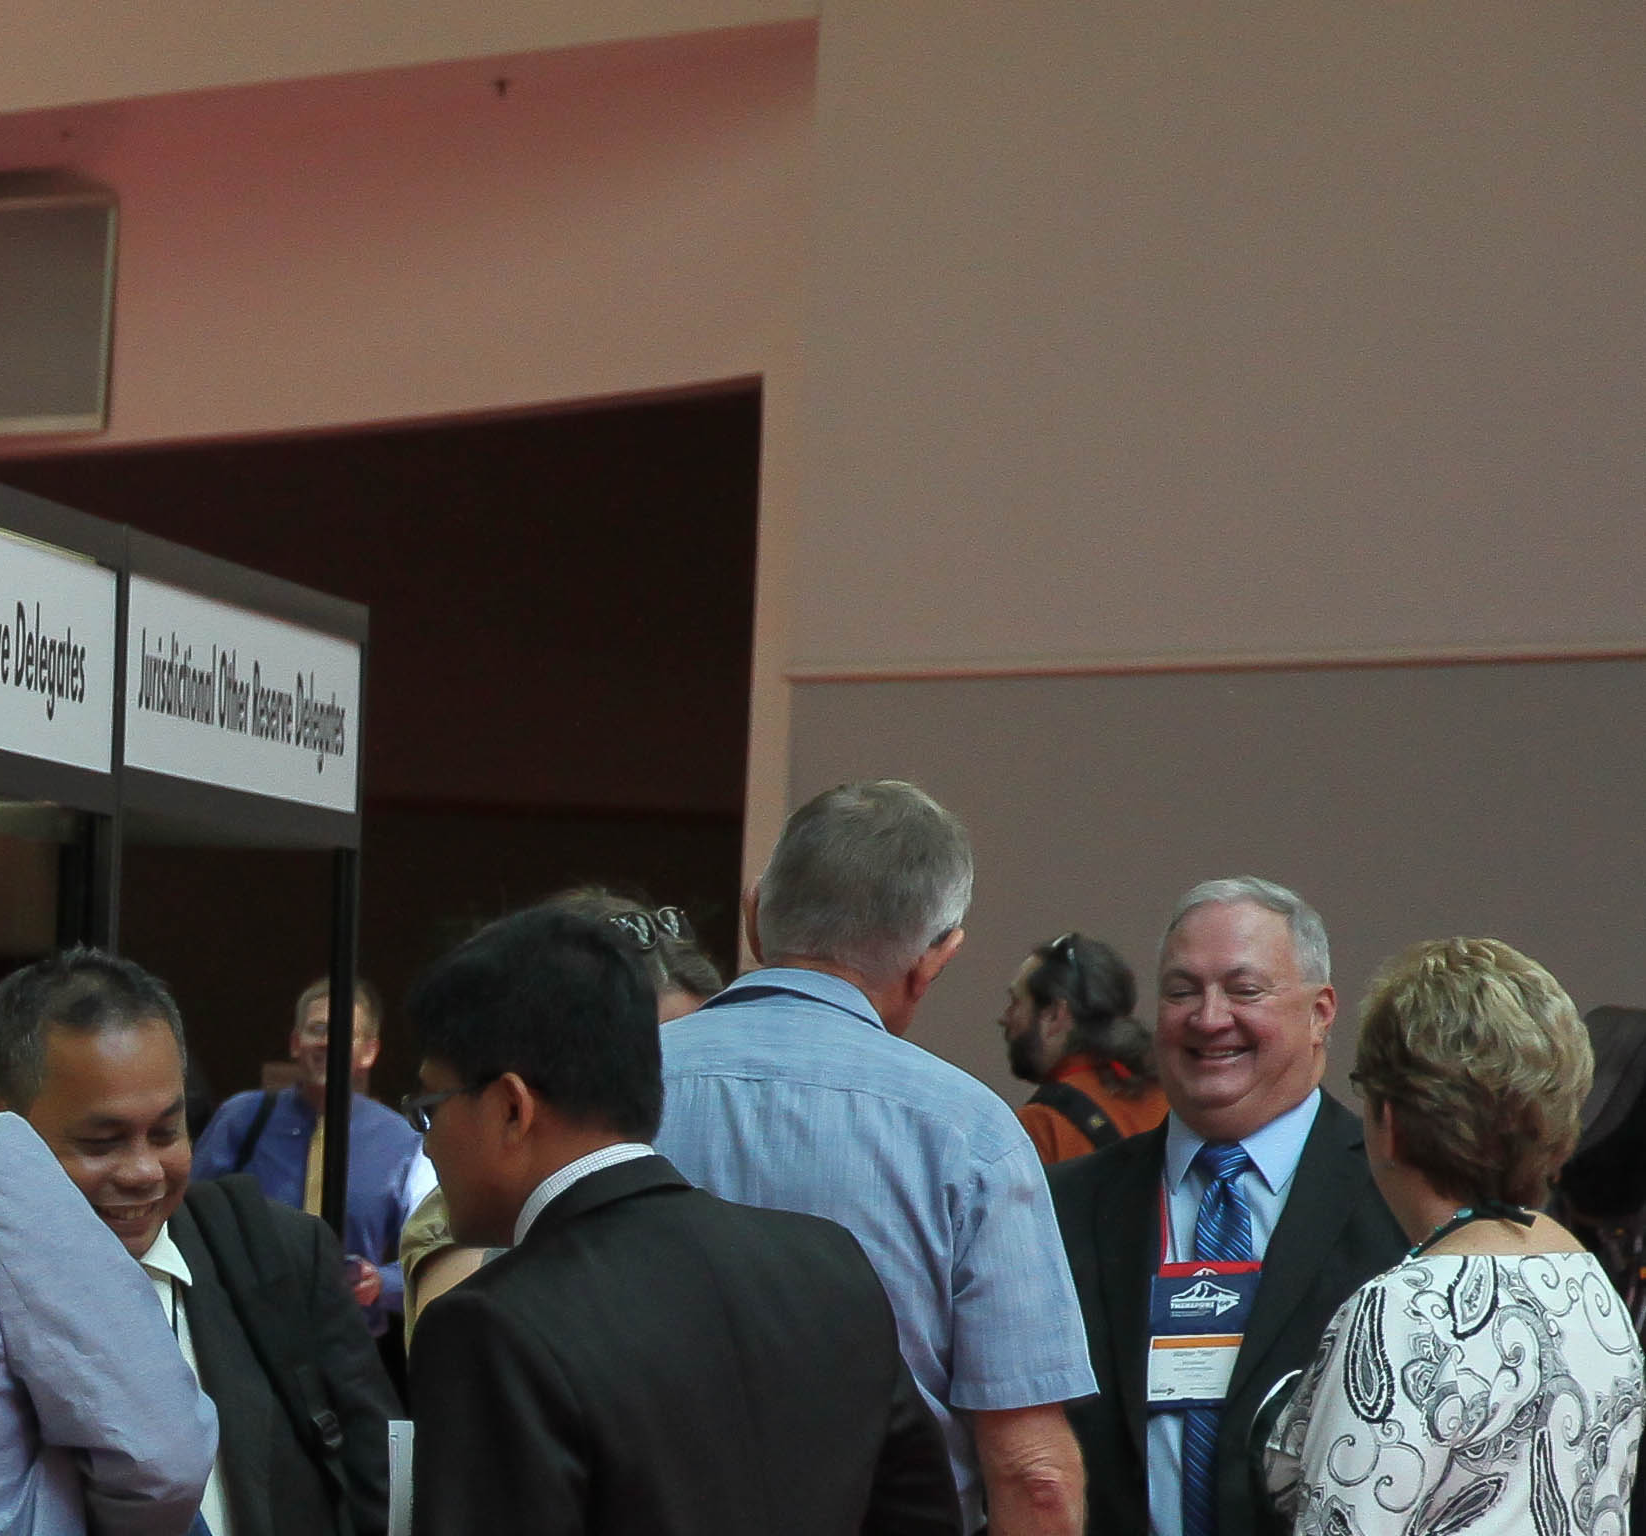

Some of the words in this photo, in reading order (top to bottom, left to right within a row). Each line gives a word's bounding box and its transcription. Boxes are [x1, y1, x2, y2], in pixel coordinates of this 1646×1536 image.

[14, 601, 86, 721] Delegates
[138, 627, 217, 725] Jurisdictional
[219, 649, 250, 735] Other
[252, 660, 293, 746] Reserve
[295, 671, 346, 774] Delegates
